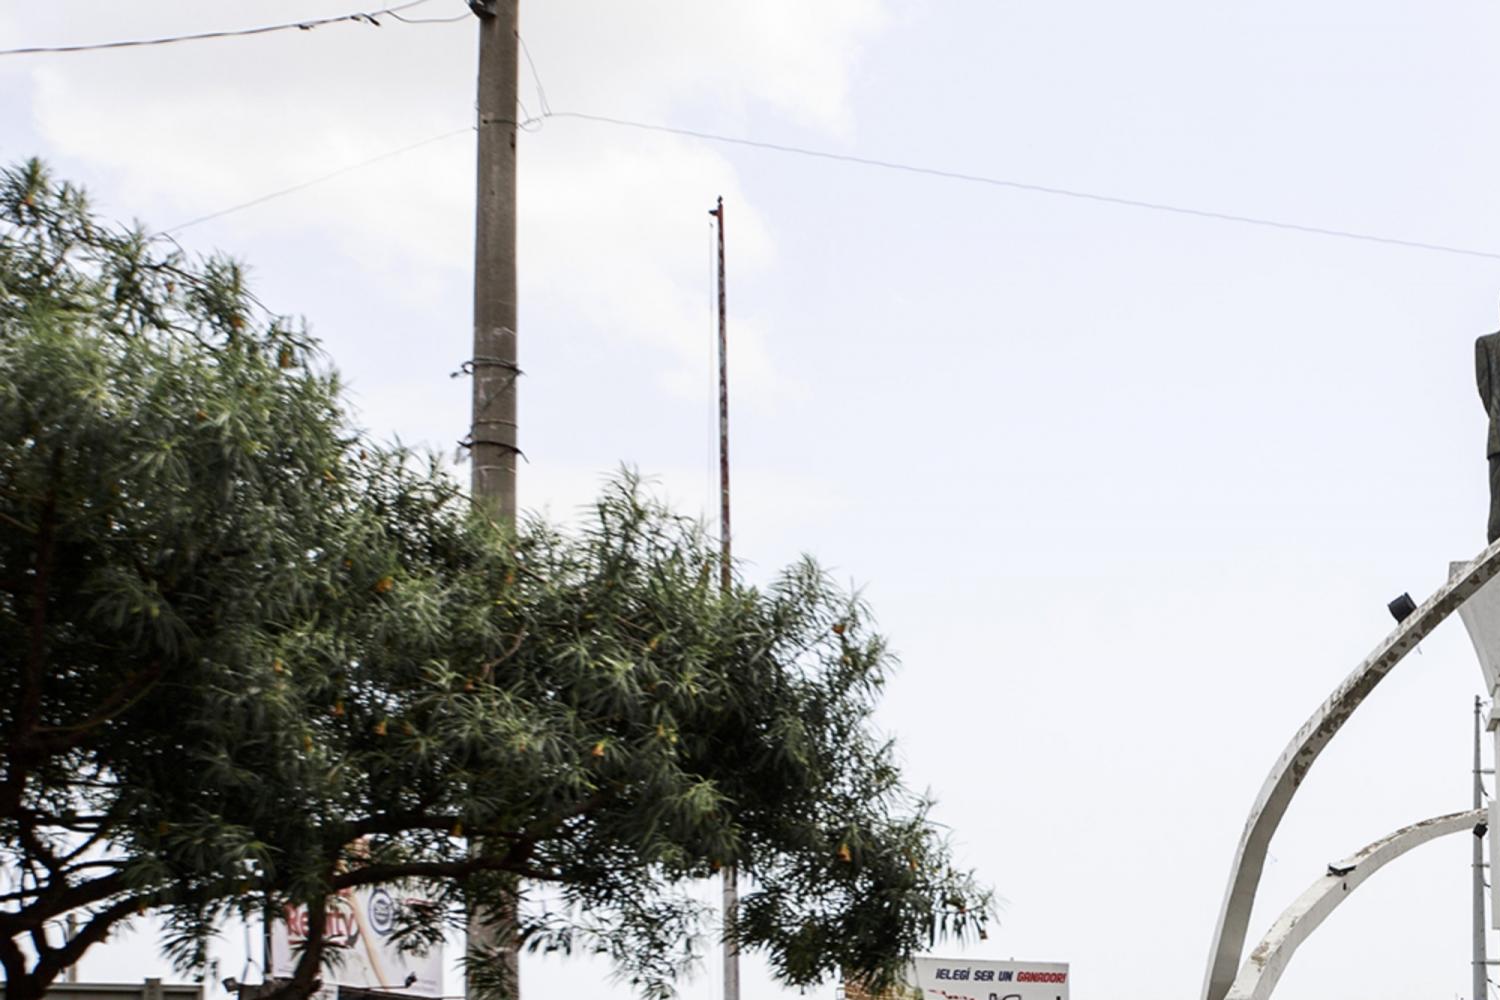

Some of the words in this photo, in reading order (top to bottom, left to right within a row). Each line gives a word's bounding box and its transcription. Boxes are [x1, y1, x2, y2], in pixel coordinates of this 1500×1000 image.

[936, 967, 971, 980] ¡ELEGÍ
[974, 970, 994, 981] SER
[998, 971, 1013, 981] UN
[1017, 971, 1067, 984] GANADOR!
